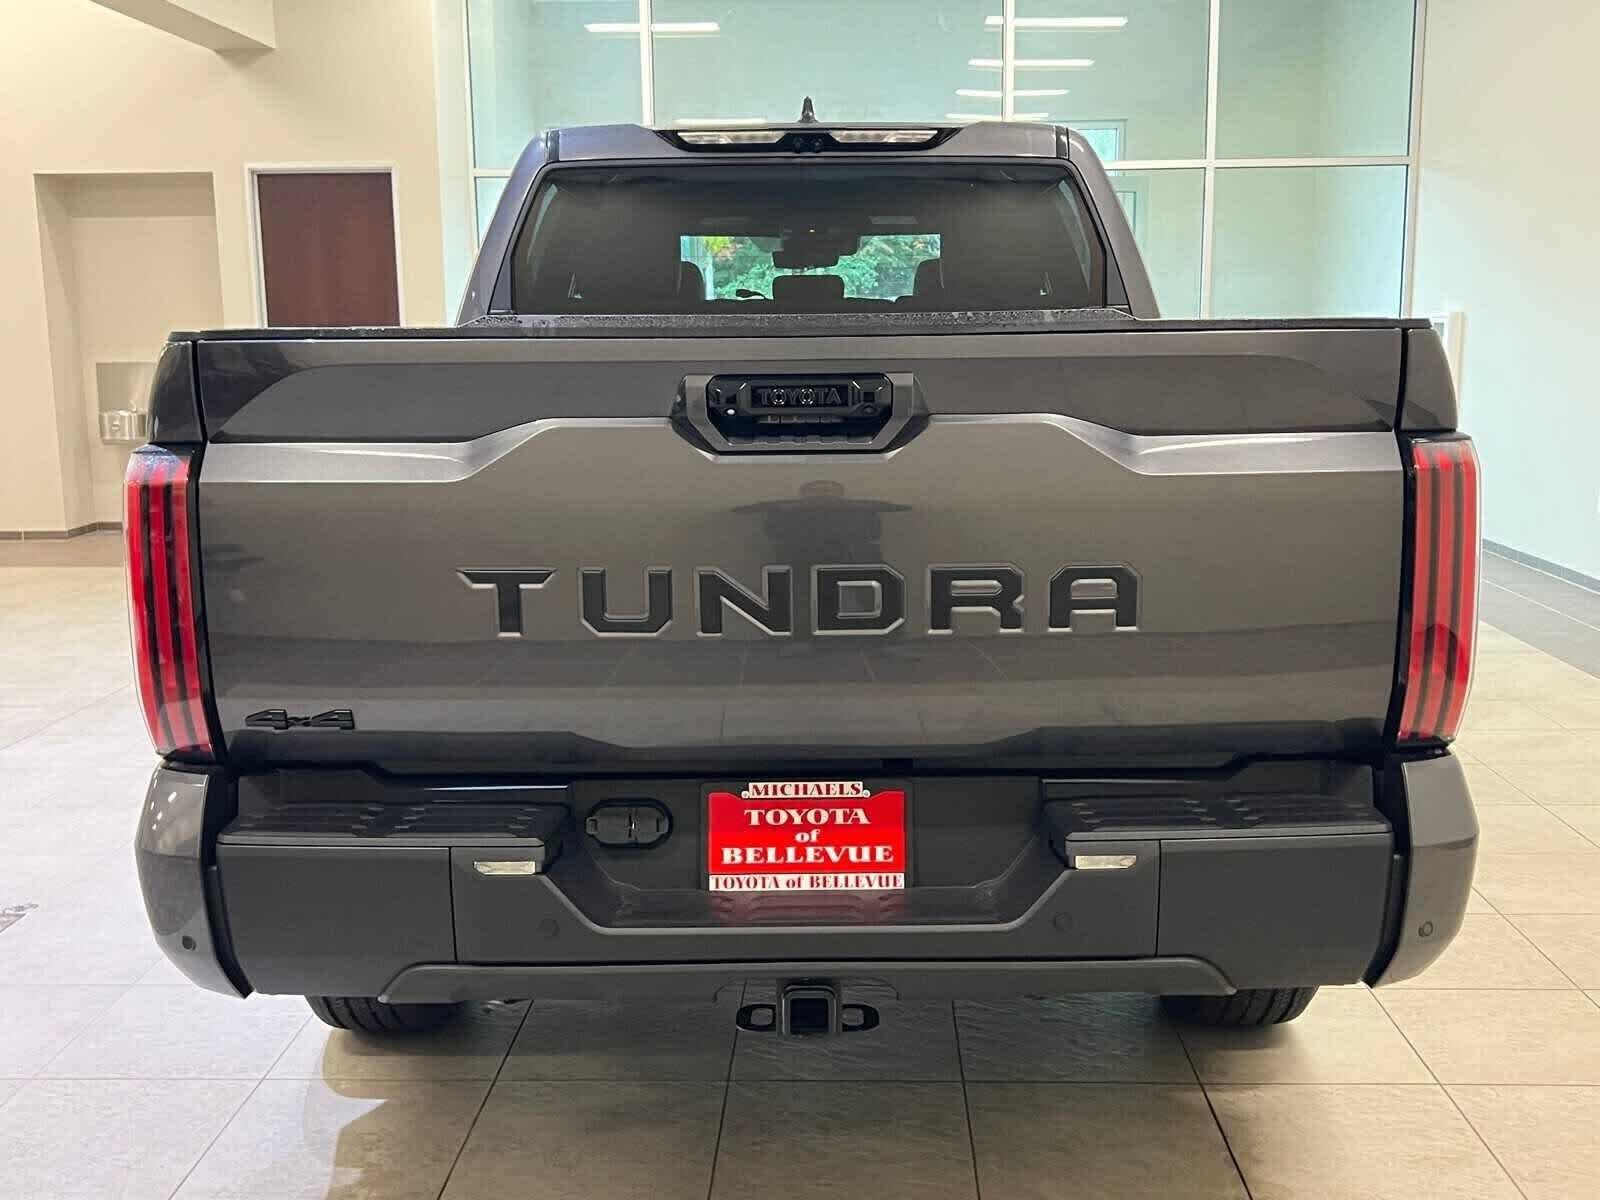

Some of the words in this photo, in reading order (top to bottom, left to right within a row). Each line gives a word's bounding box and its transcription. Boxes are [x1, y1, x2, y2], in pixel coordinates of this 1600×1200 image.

[758, 387, 843, 405] TOYOTA
[456, 564, 1142, 638] TUNDRA
[751, 783, 861, 796] MICHAELS
[744, 808, 871, 826] TOYOTA
[795, 829, 820, 843] of
[721, 845, 894, 864] BELLEVUE
[712, 876, 779, 889] TOYOTA
[786, 875, 803, 888] of
[810, 875, 903, 888] BELLEVUE
